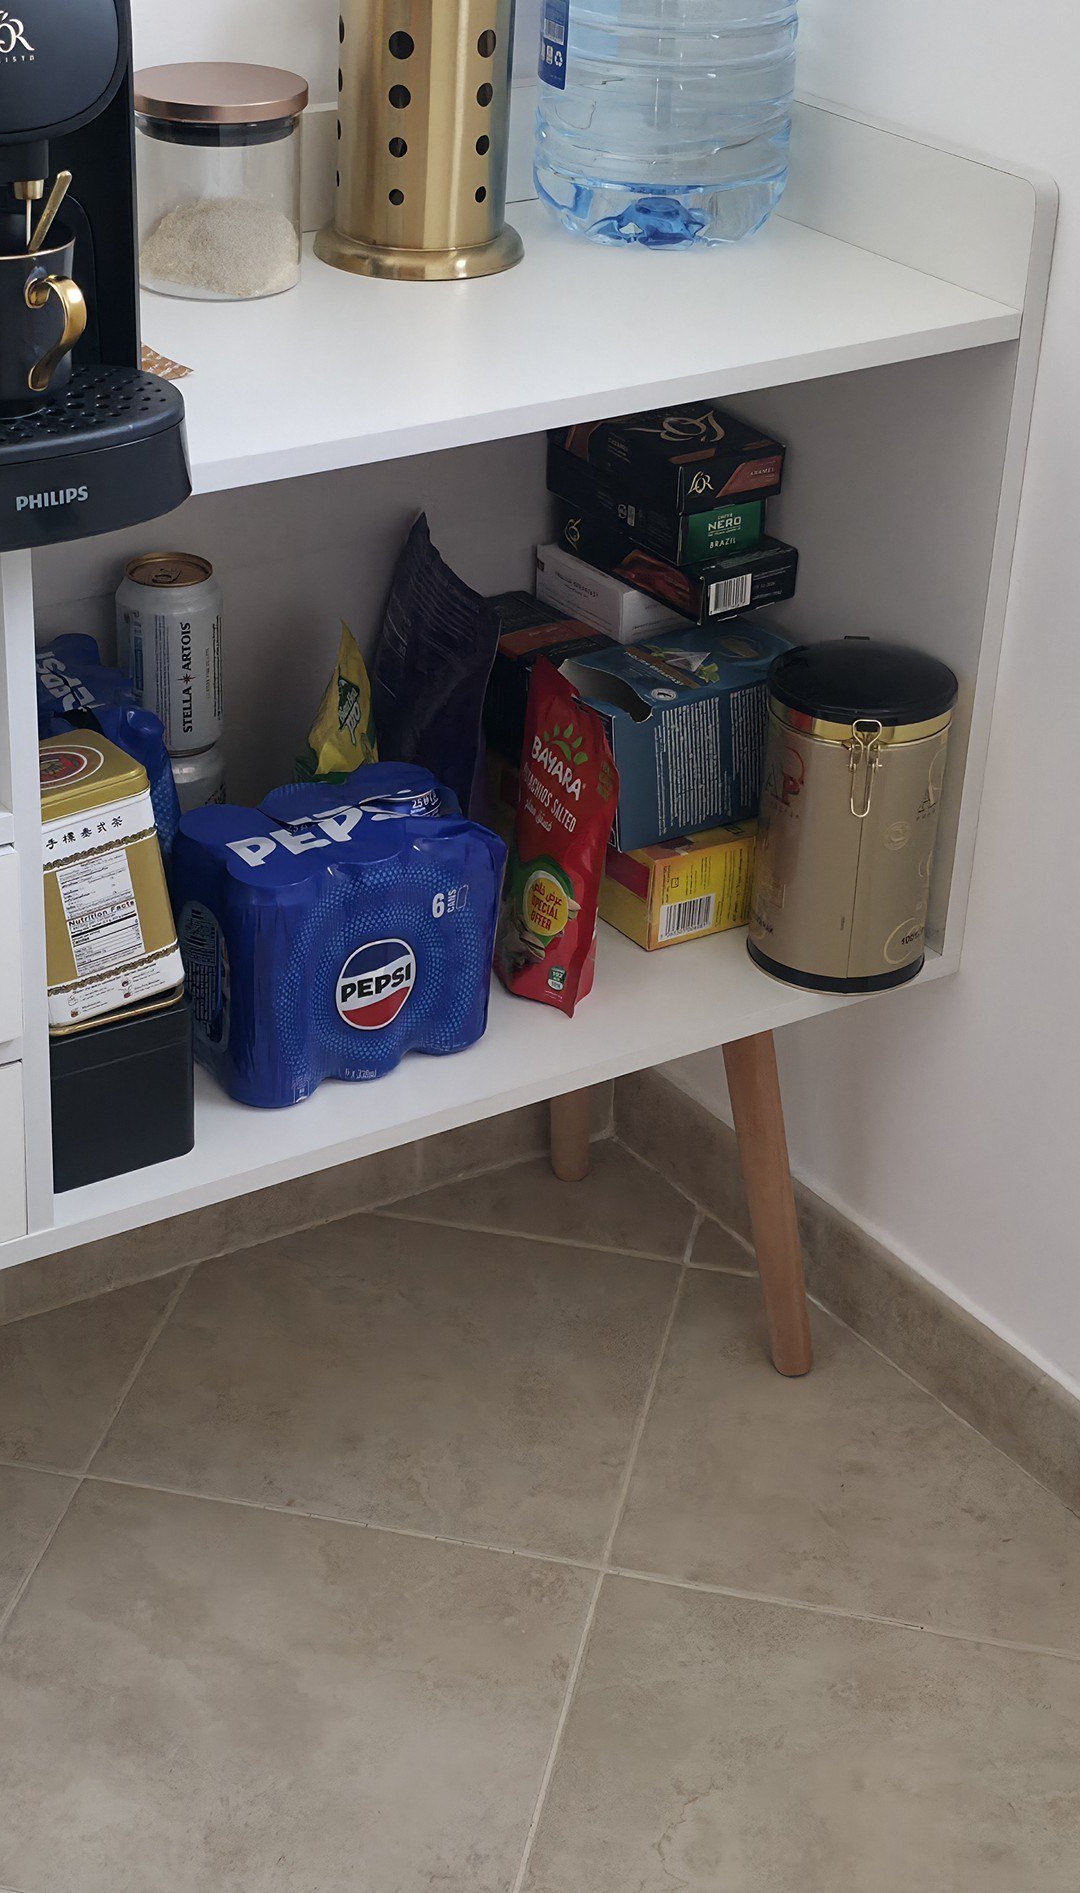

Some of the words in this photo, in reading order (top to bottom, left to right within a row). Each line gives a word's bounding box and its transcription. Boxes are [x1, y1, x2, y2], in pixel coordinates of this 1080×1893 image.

[15, 485, 89, 512] PHILIPS
[708, 516, 742, 531] NERO
[709, 537, 736, 549] BRAZIL
[180, 622, 193, 671] ARTOIS
[182, 686, 193, 733] STELLA
[531, 735, 582, 801] BAYARA
[550, 798, 577, 833] SALTED
[432, 892, 445, 918] 6
[446, 888, 458, 913] CANS
[531, 895, 559, 920] SPECIAL
[68, 908, 108, 927] Nutrition
[530, 911, 552, 931] OFFER
[341, 962, 411, 1003] PEPSI
